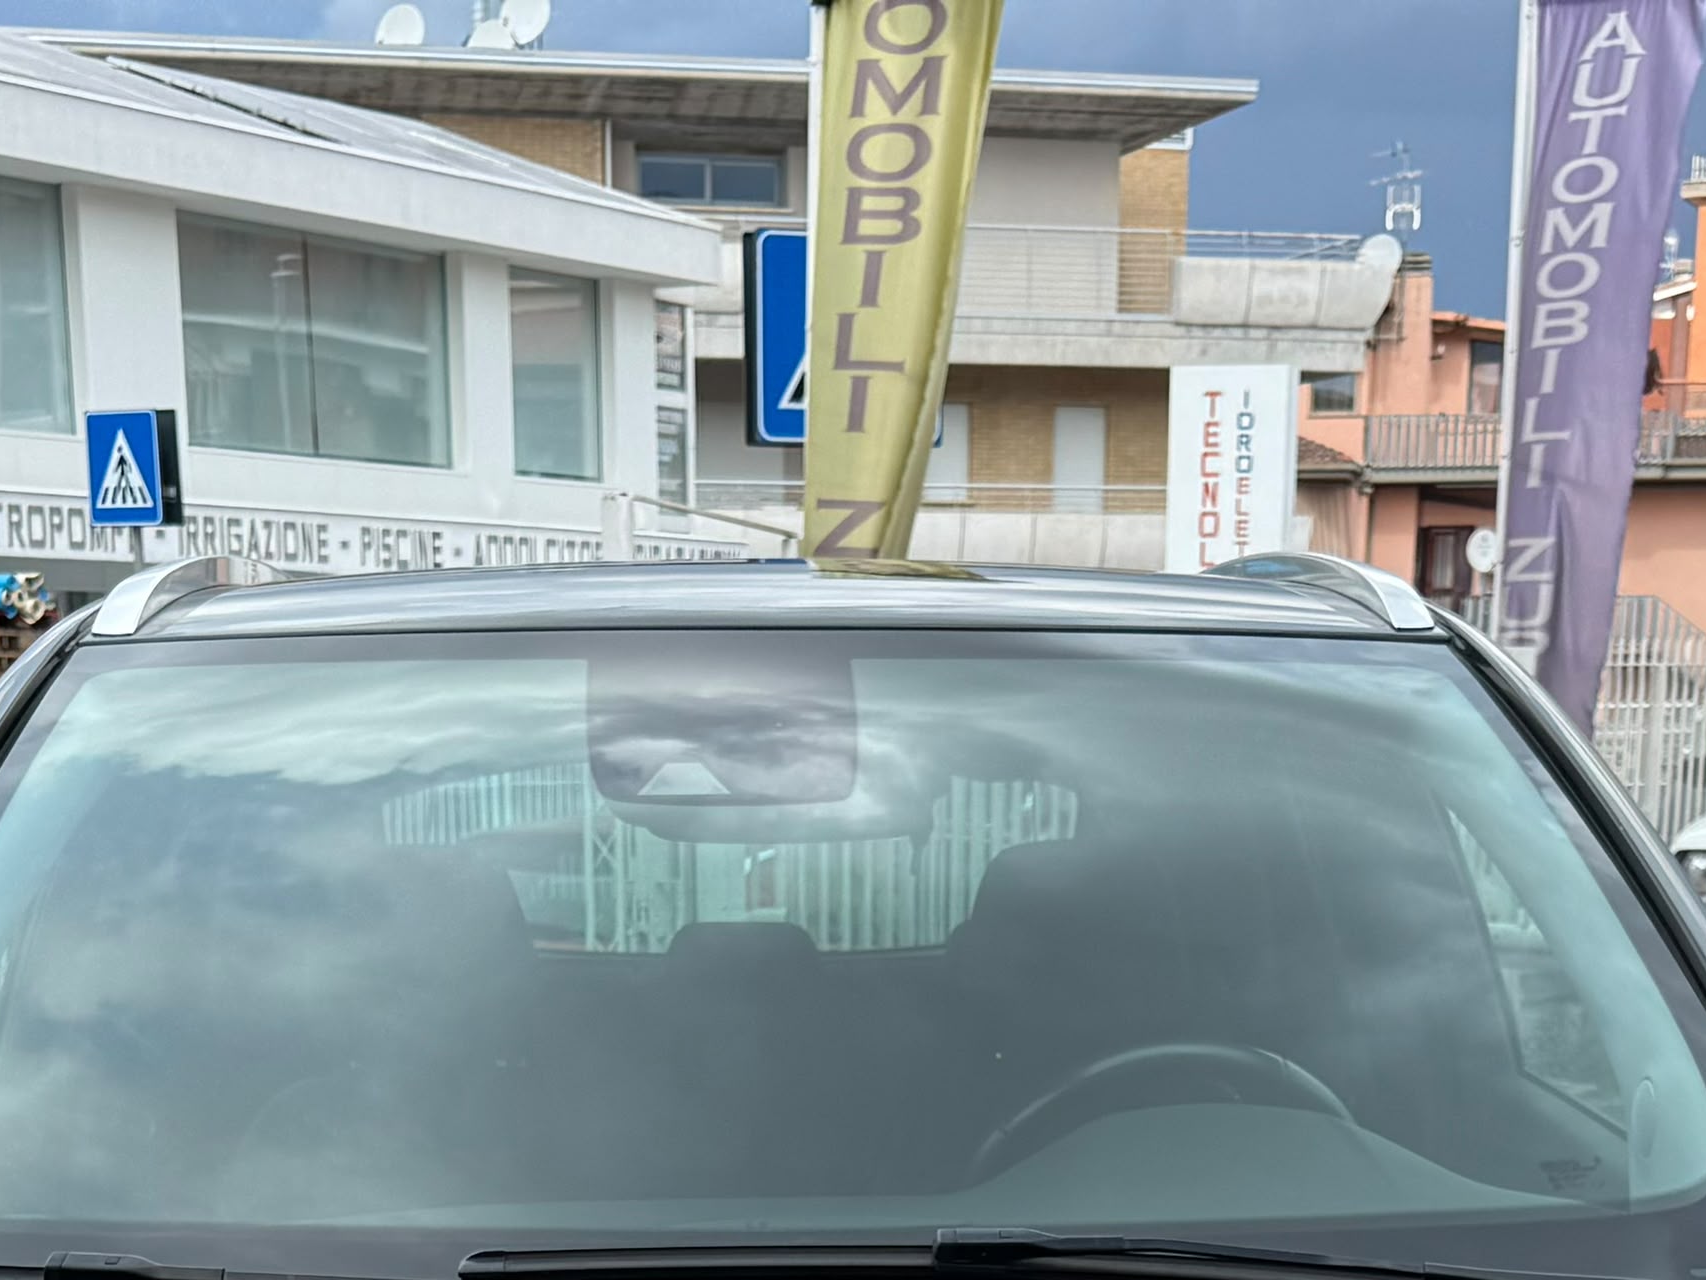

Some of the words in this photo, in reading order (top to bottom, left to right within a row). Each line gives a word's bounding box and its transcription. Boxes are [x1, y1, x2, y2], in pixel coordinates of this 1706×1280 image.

[1520, 10, 1647, 489] AUTOMOBILI
[177, 515, 331, 564] IRRIGAZIONE
[360, 526, 453, 570] PISCINE
